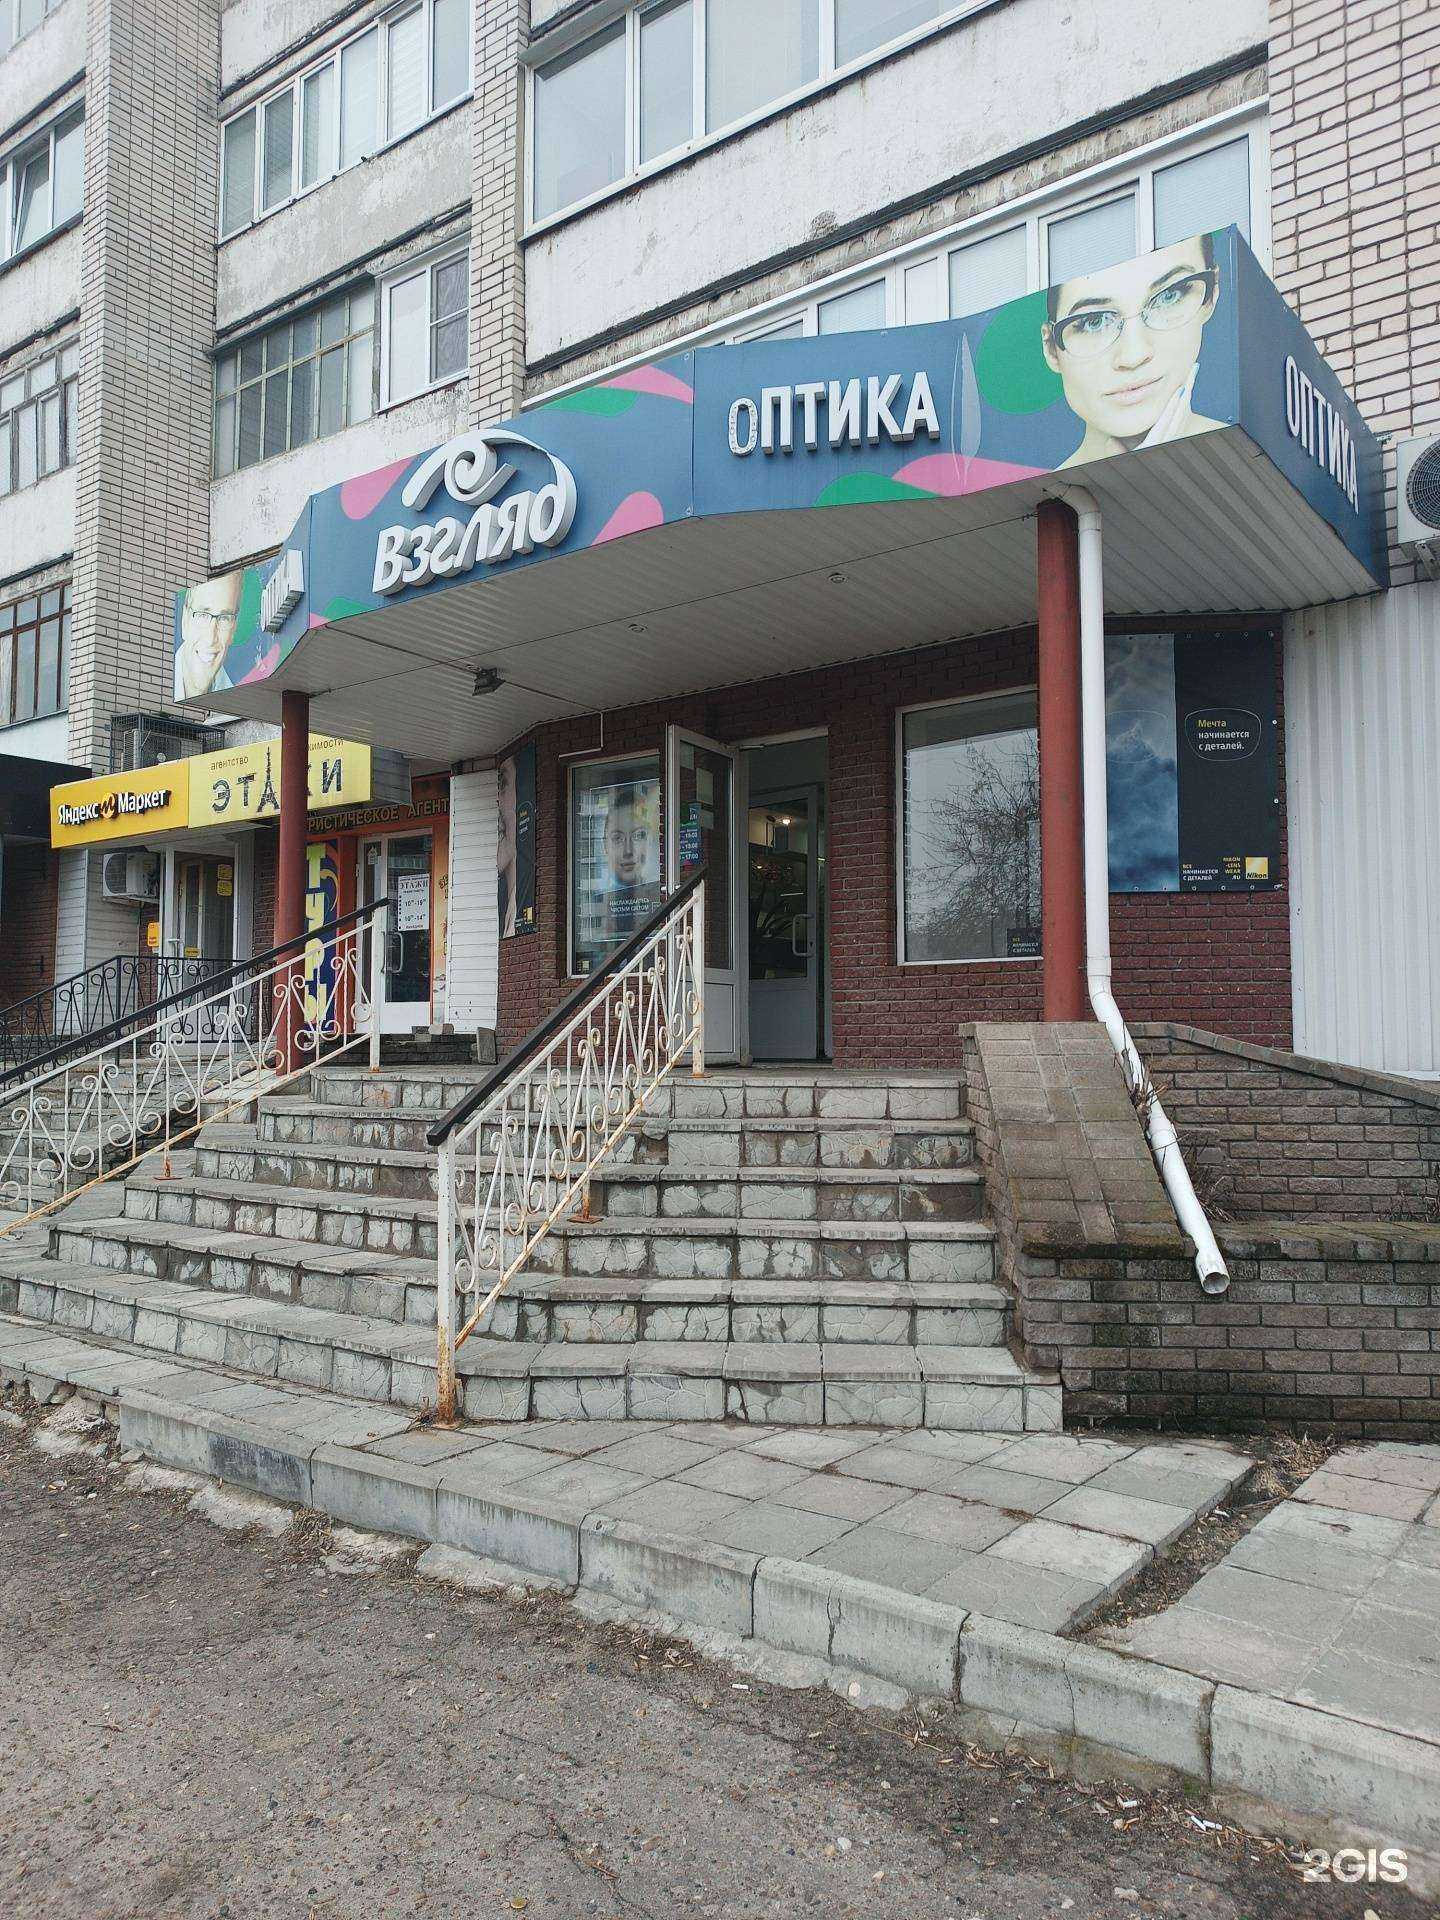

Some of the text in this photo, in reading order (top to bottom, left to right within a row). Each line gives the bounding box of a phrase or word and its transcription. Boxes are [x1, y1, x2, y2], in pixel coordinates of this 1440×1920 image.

[728, 371, 940, 457] ОПТИКА
[1284, 355, 1359, 515] ОПТИКА
[1198, 719, 1227, 728] Мечта
[1198, 730, 1250, 739] начинается
[1204, 741, 1245, 751] деталей.
[210, 756, 249, 771] агентство
[211, 746, 343, 814] ЭТАИ
[57, 789, 168, 826] Яндекс Маркет
[307, 798, 449, 833] РИСТИЧЕСКОЕ АГЕНТ
[1246, 871, 1268, 879] Nikon
